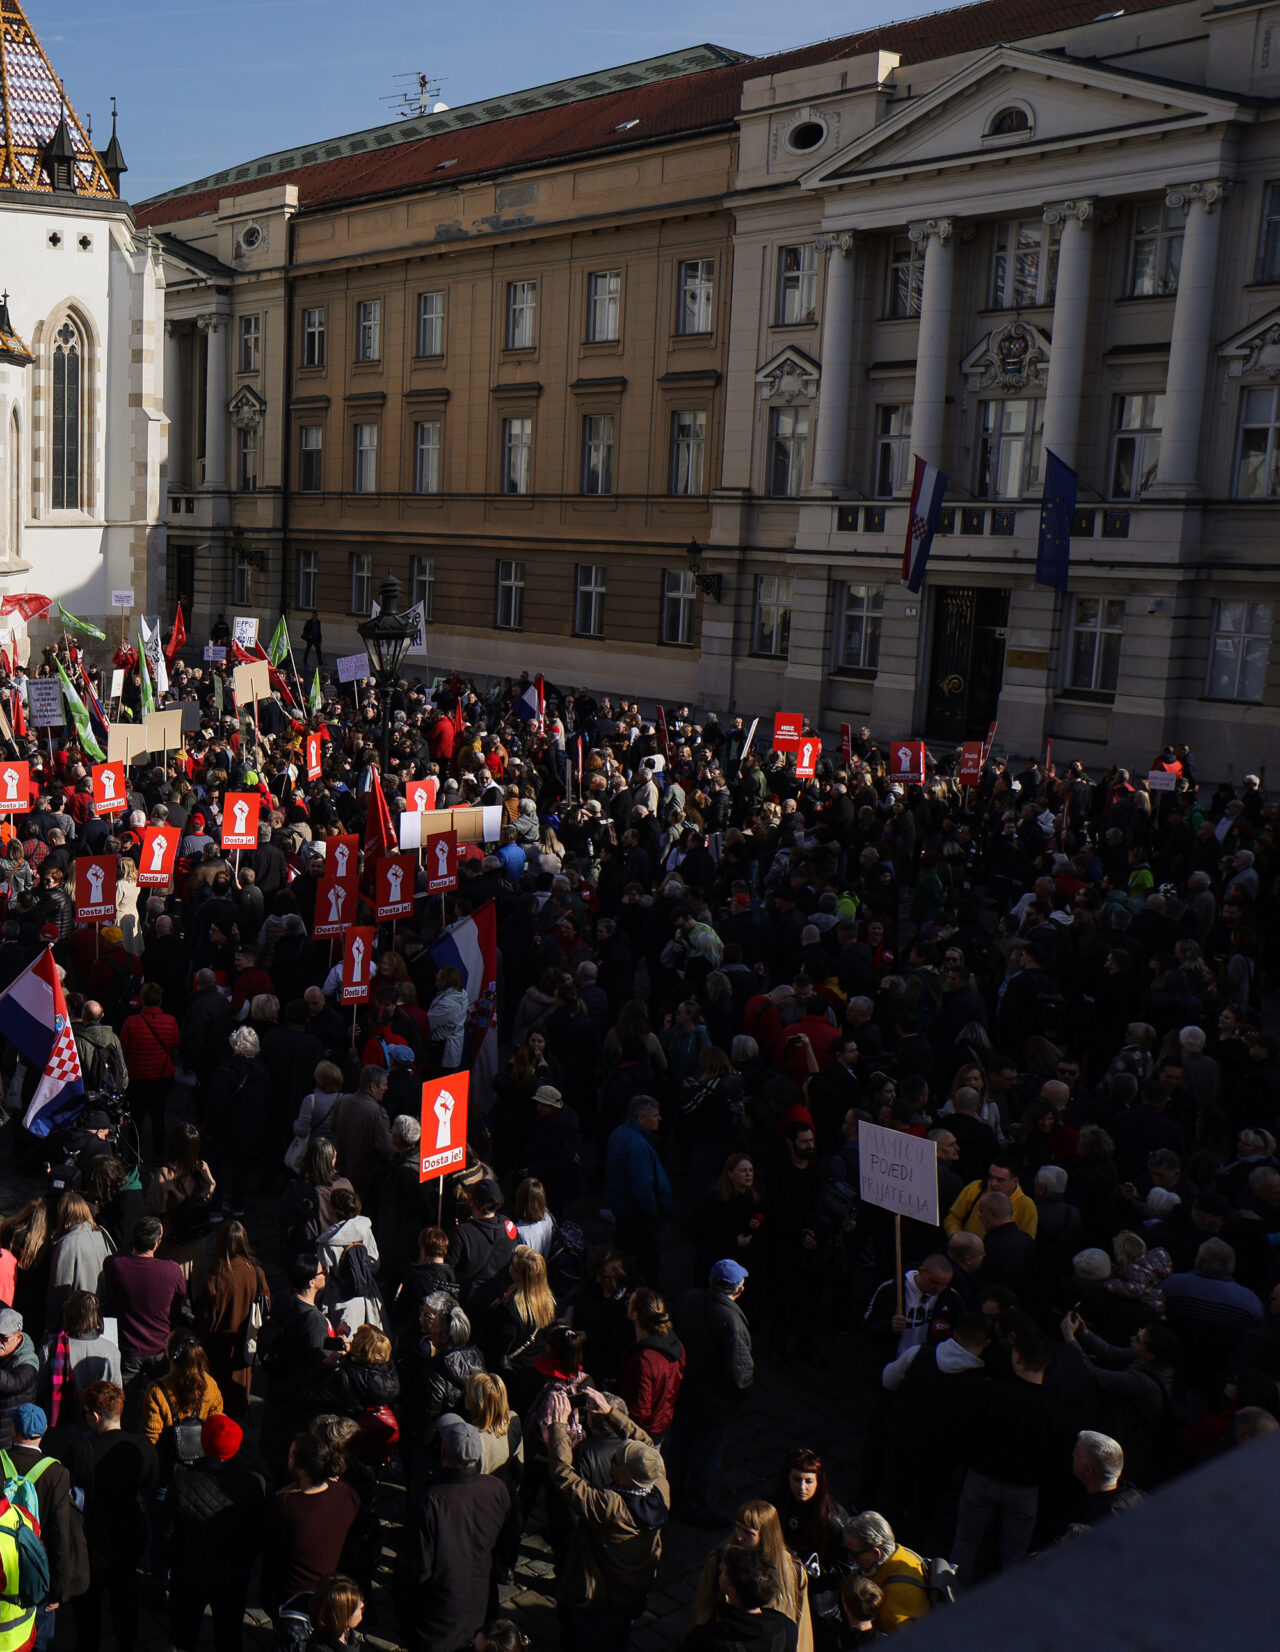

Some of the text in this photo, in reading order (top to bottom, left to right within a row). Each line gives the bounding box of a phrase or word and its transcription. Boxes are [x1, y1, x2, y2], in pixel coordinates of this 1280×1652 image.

[97, 799, 125, 810] Dosta je!
[246, 836, 255, 845] je!
[139, 875, 169, 884] Dosta je!
[430, 880, 447, 889] Dosta
[79, 906, 113, 917] Dosta je!
[379, 904, 411, 916] Dosta je!
[316, 925, 339, 934] Dosta
[344, 988, 360, 997] Dosta
[424, 1149, 462, 1170] Dosta je!
